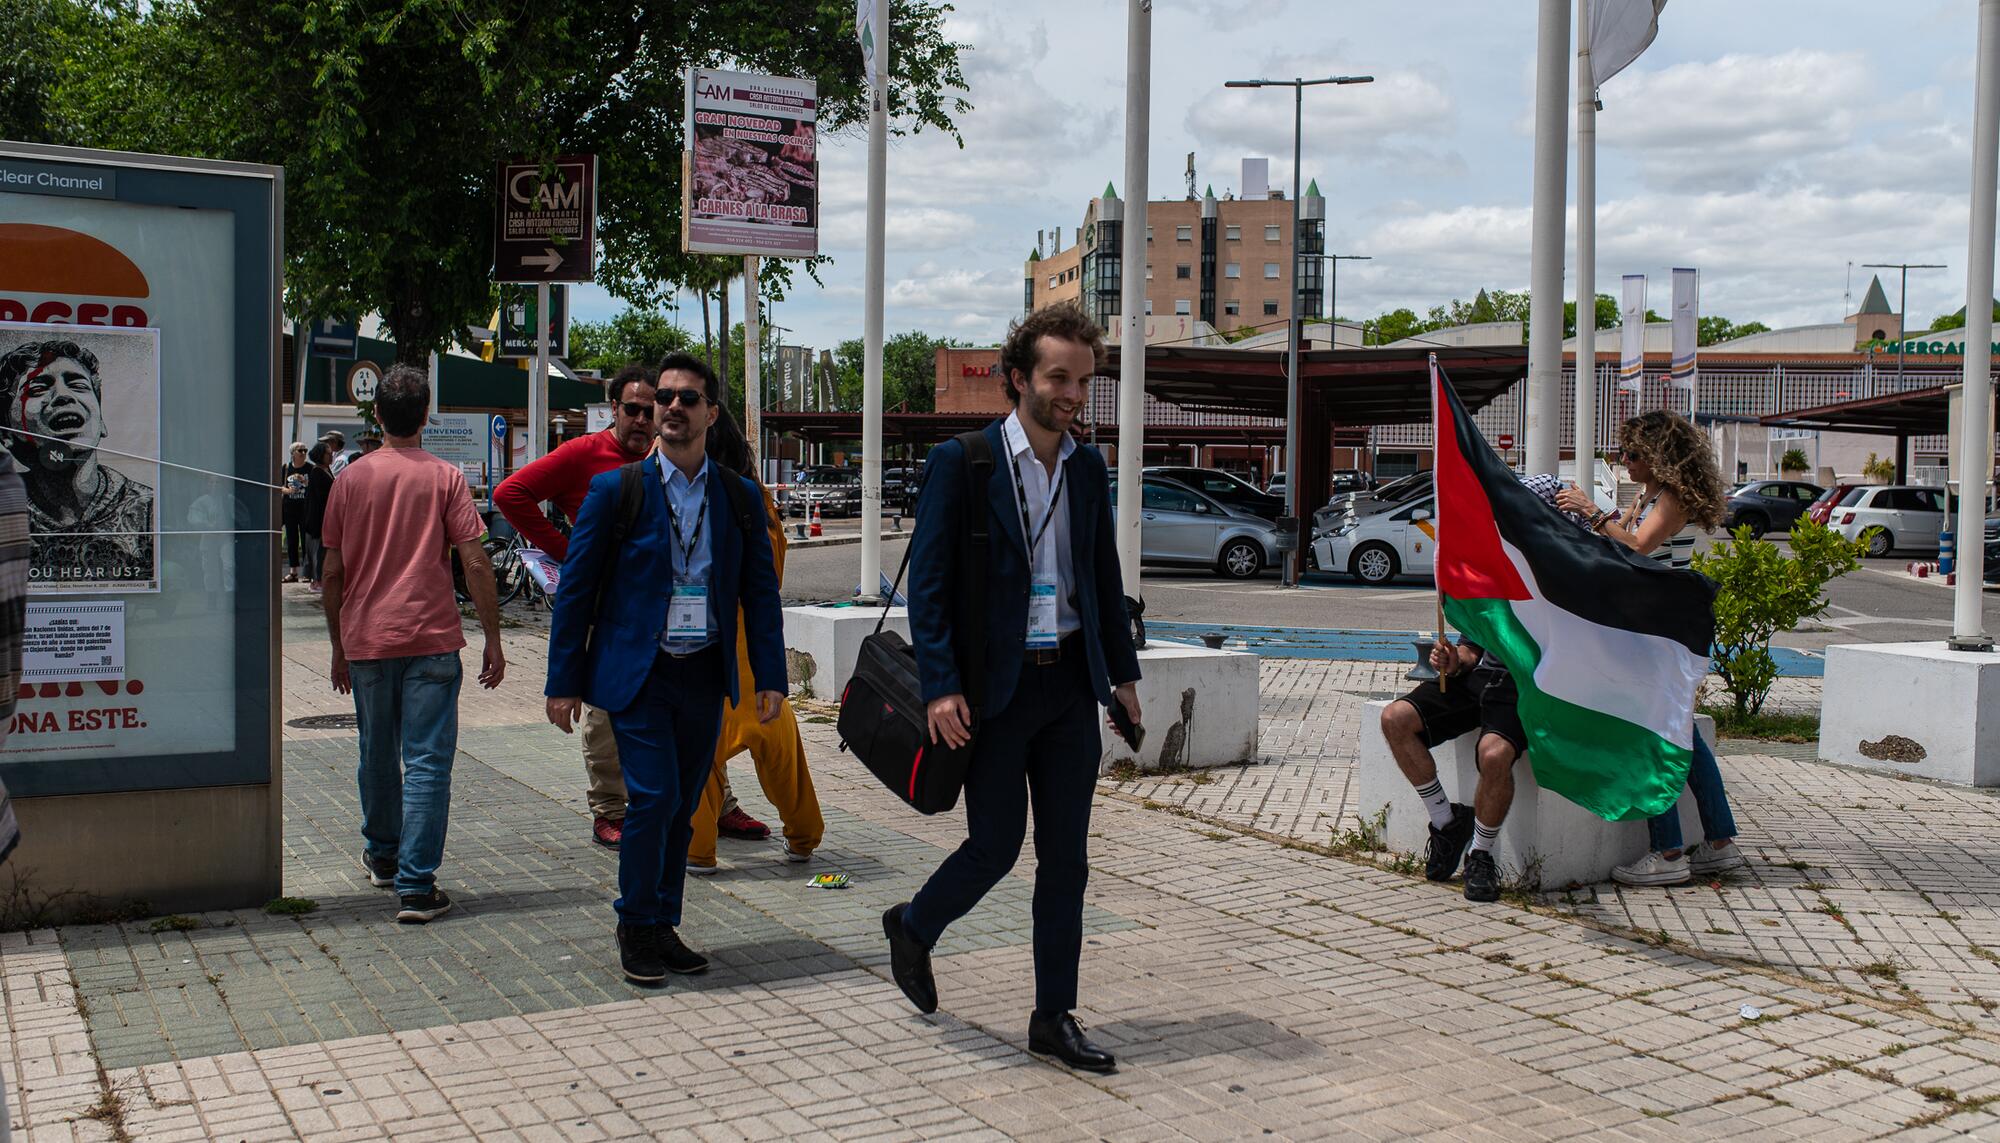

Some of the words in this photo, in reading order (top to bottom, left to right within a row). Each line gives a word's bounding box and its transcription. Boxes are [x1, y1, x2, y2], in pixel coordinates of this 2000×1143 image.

[750, 92, 763, 102] CASA
[695, 112, 726, 126] GRAN
[728, 114, 781, 132] NOVEDAD
[723, 128, 735, 138] EN
[736, 130, 777, 143] NUESTRAS
[778, 134, 814, 147] COCINAS
[37, 172, 103, 190] Channel
[510, 170, 580, 210] CAM
[699, 198, 743, 216] CARNES
[745, 202, 753, 217] A
[754, 203, 768, 219] LA
[770, 204, 808, 223] BRASA
[509, 218, 525, 228] CASA
[526, 218, 551, 227] ANTONIO
[553, 217, 578, 227] MORENO
[505, 339, 558, 348] MERCDA
[360, 371, 364, 379] 2
[28, 567, 52, 578] OU
[60, 567, 105, 578] HEAR
[112, 566, 141, 577] US?
[68, 707, 147, 731] ESTE.
